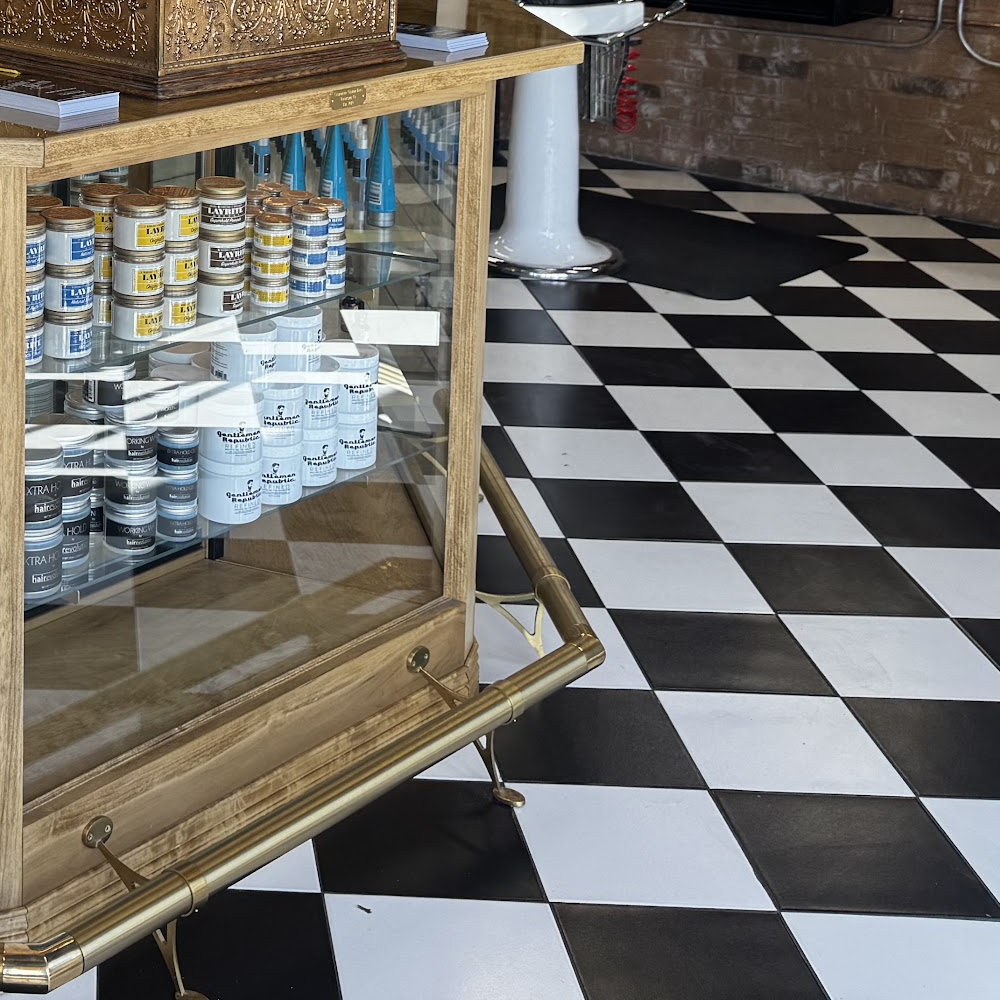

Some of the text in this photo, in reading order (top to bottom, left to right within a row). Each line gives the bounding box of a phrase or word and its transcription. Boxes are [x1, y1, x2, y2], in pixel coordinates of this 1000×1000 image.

[207, 206, 243, 216] LAYRITE
[126, 436, 149, 446] ORKING
[26, 484, 50, 496] XTRA
